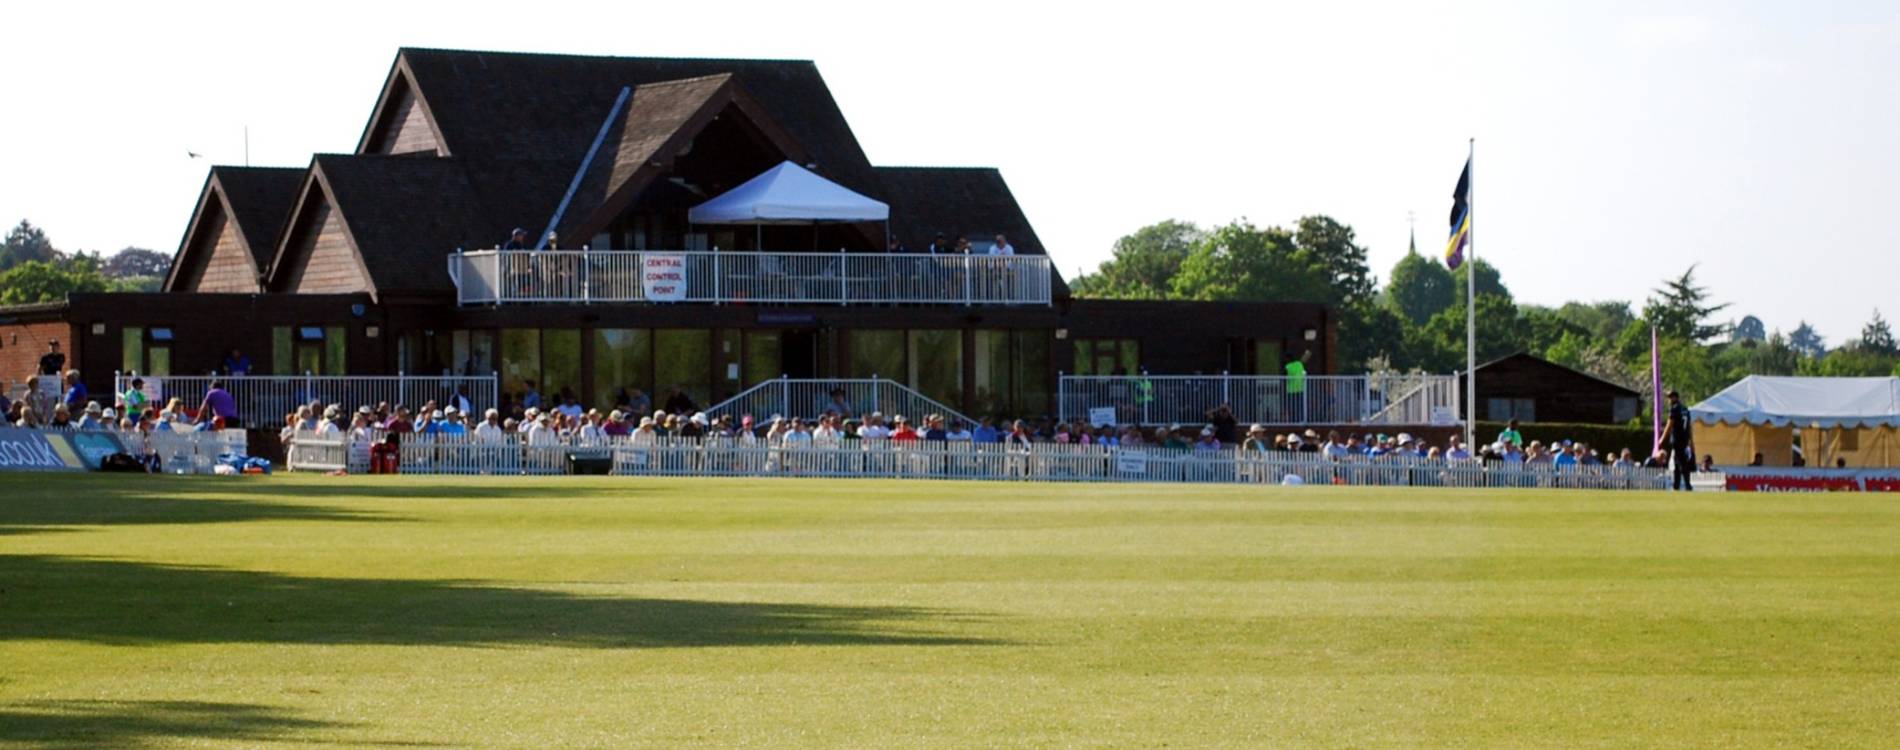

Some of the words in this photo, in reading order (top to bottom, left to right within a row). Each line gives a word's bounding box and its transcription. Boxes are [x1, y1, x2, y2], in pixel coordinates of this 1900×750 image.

[647, 259, 682, 267] CENTRAL
[647, 273, 682, 281] CONTROL
[653, 286, 676, 294] POINT
